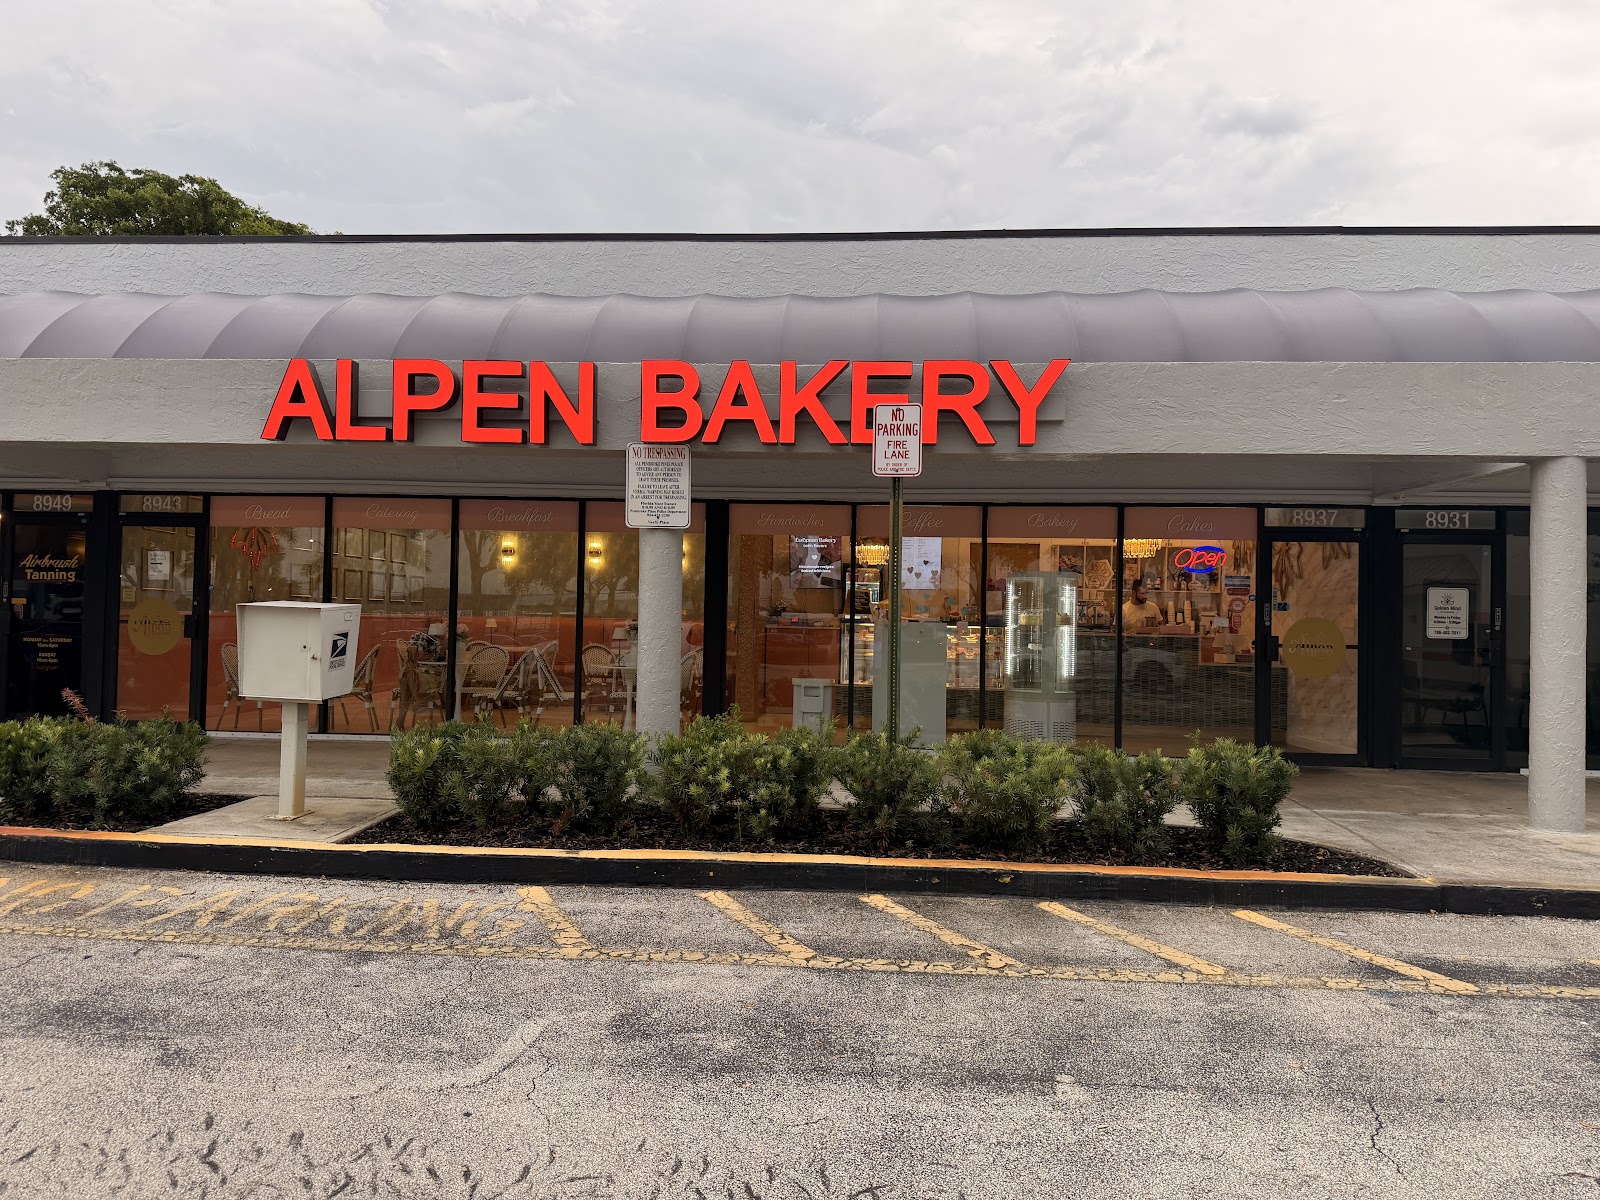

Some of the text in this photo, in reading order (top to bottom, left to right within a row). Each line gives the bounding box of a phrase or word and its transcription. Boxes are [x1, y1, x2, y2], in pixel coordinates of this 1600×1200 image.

[261, 358, 1071, 446] ALPEN BAKERY
[892, 408, 904, 422] NO
[878, 423, 918, 436] PARKING
[887, 440, 908, 449] FIRE
[632, 447, 686, 459] NO TRESPASSING
[884, 450, 910, 459] LANE
[33, 495, 72, 512] 8949
[142, 496, 182, 512] 8943
[244, 504, 292, 520] Bread
[366, 504, 420, 524] Catering
[487, 507, 554, 526] Breakfast
[757, 512, 824, 527] Sandwiches
[1292, 510, 1338, 526] 8937
[1426, 512, 1470, 528] 8931
[1027, 513, 1079, 533] Bakery
[1167, 514, 1216, 532] Cakes
[18, 554, 80, 568] Airbrush
[1175, 548, 1228, 568] Open
[25, 569, 76, 582] Tanning
